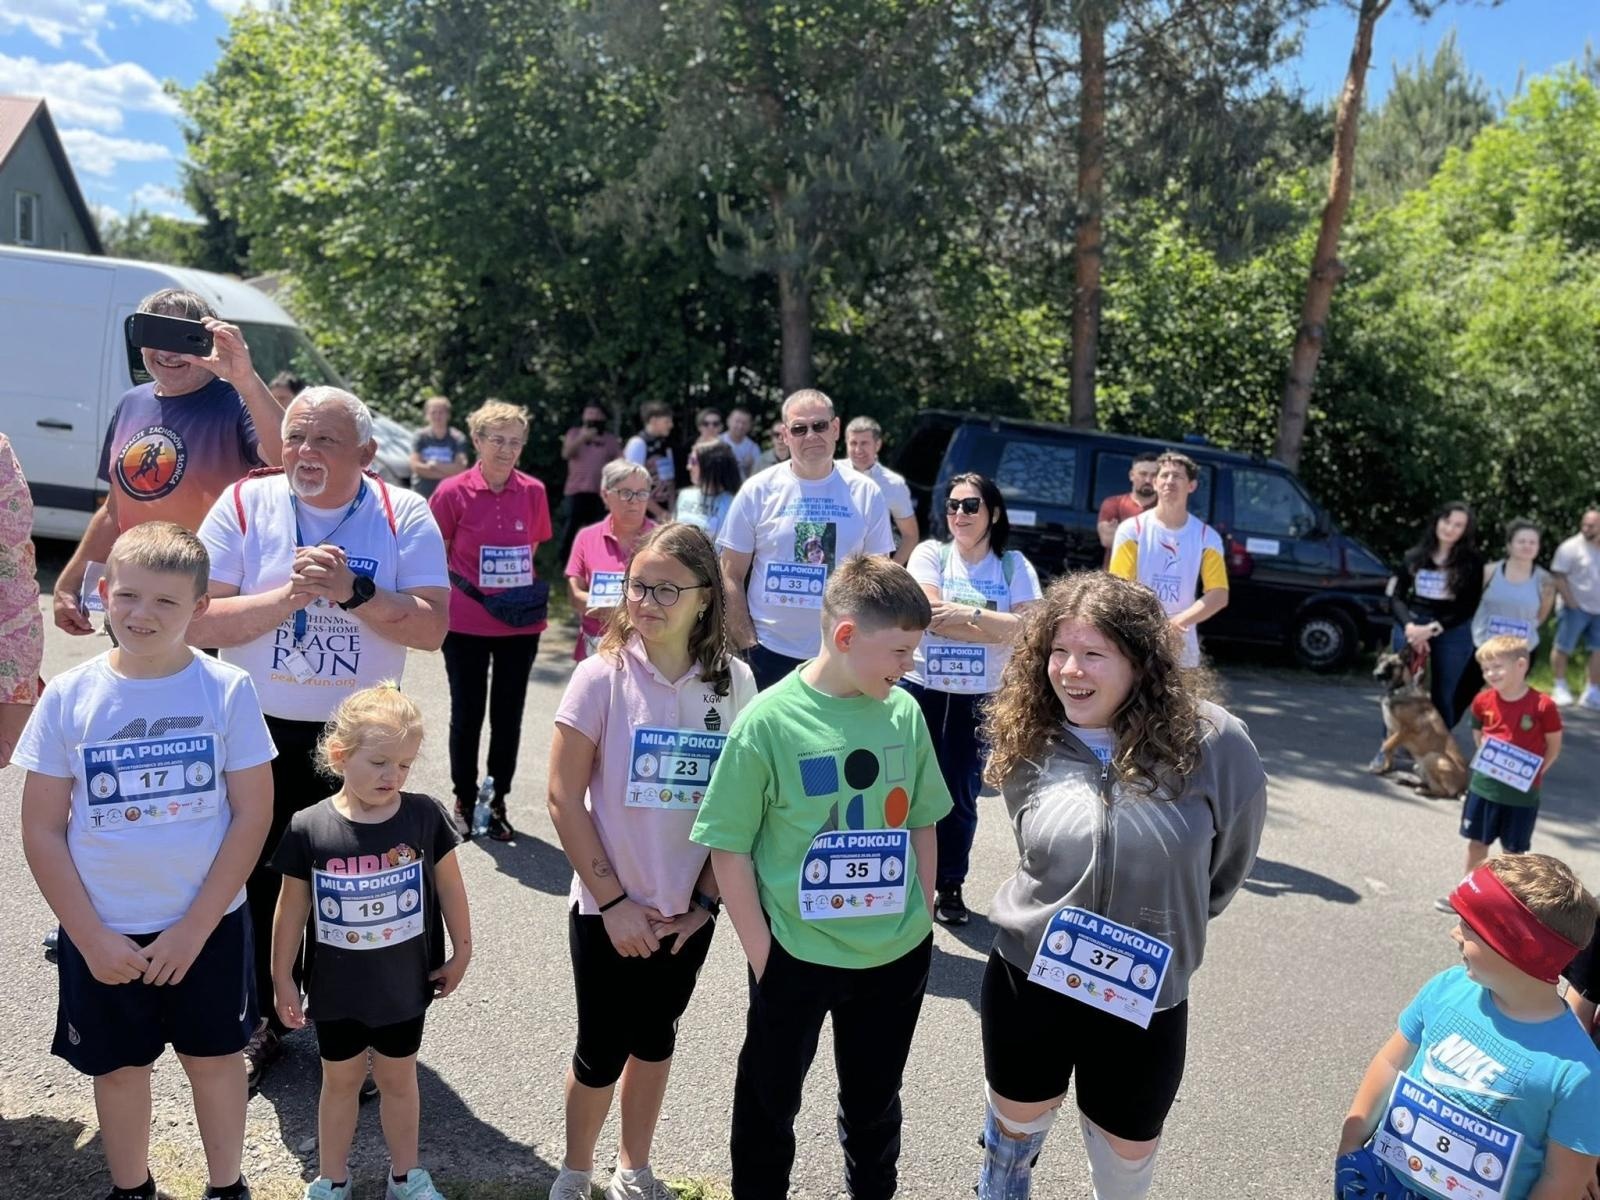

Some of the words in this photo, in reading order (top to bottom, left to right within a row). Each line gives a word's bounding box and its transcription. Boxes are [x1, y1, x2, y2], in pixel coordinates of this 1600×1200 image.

[504, 562, 516, 570] 16
[770, 564, 790, 573] MILA
[791, 566, 823, 575] POKOJU
[788, 580, 802, 589] 33
[930, 647, 950, 655] MILA
[951, 648, 983, 656] POKOJU
[949, 661, 963, 671] 34
[641, 733, 676, 746] MILA
[91, 747, 135, 763] MILA
[139, 739, 207, 758] POKOJU
[675, 761, 698, 776] 23
[140, 770, 168, 788] 17
[812, 838, 845, 850] MILA
[848, 835, 901, 848] POKOJU
[846, 862, 869, 878] 35
[320, 878, 355, 892] MILA
[358, 868, 416, 891] POKOJU
[358, 902, 384, 917] 19
[1059, 910, 1098, 933] MILA
[1100, 924, 1164, 959] POKOJU
[1089, 949, 1119, 970] 37
[1430, 1032, 1507, 1090] NIKE
[1402, 1083, 1438, 1113] MILA
[1439, 1105, 1509, 1147] POKOJU
[1436, 1135, 1451, 1153] 8
